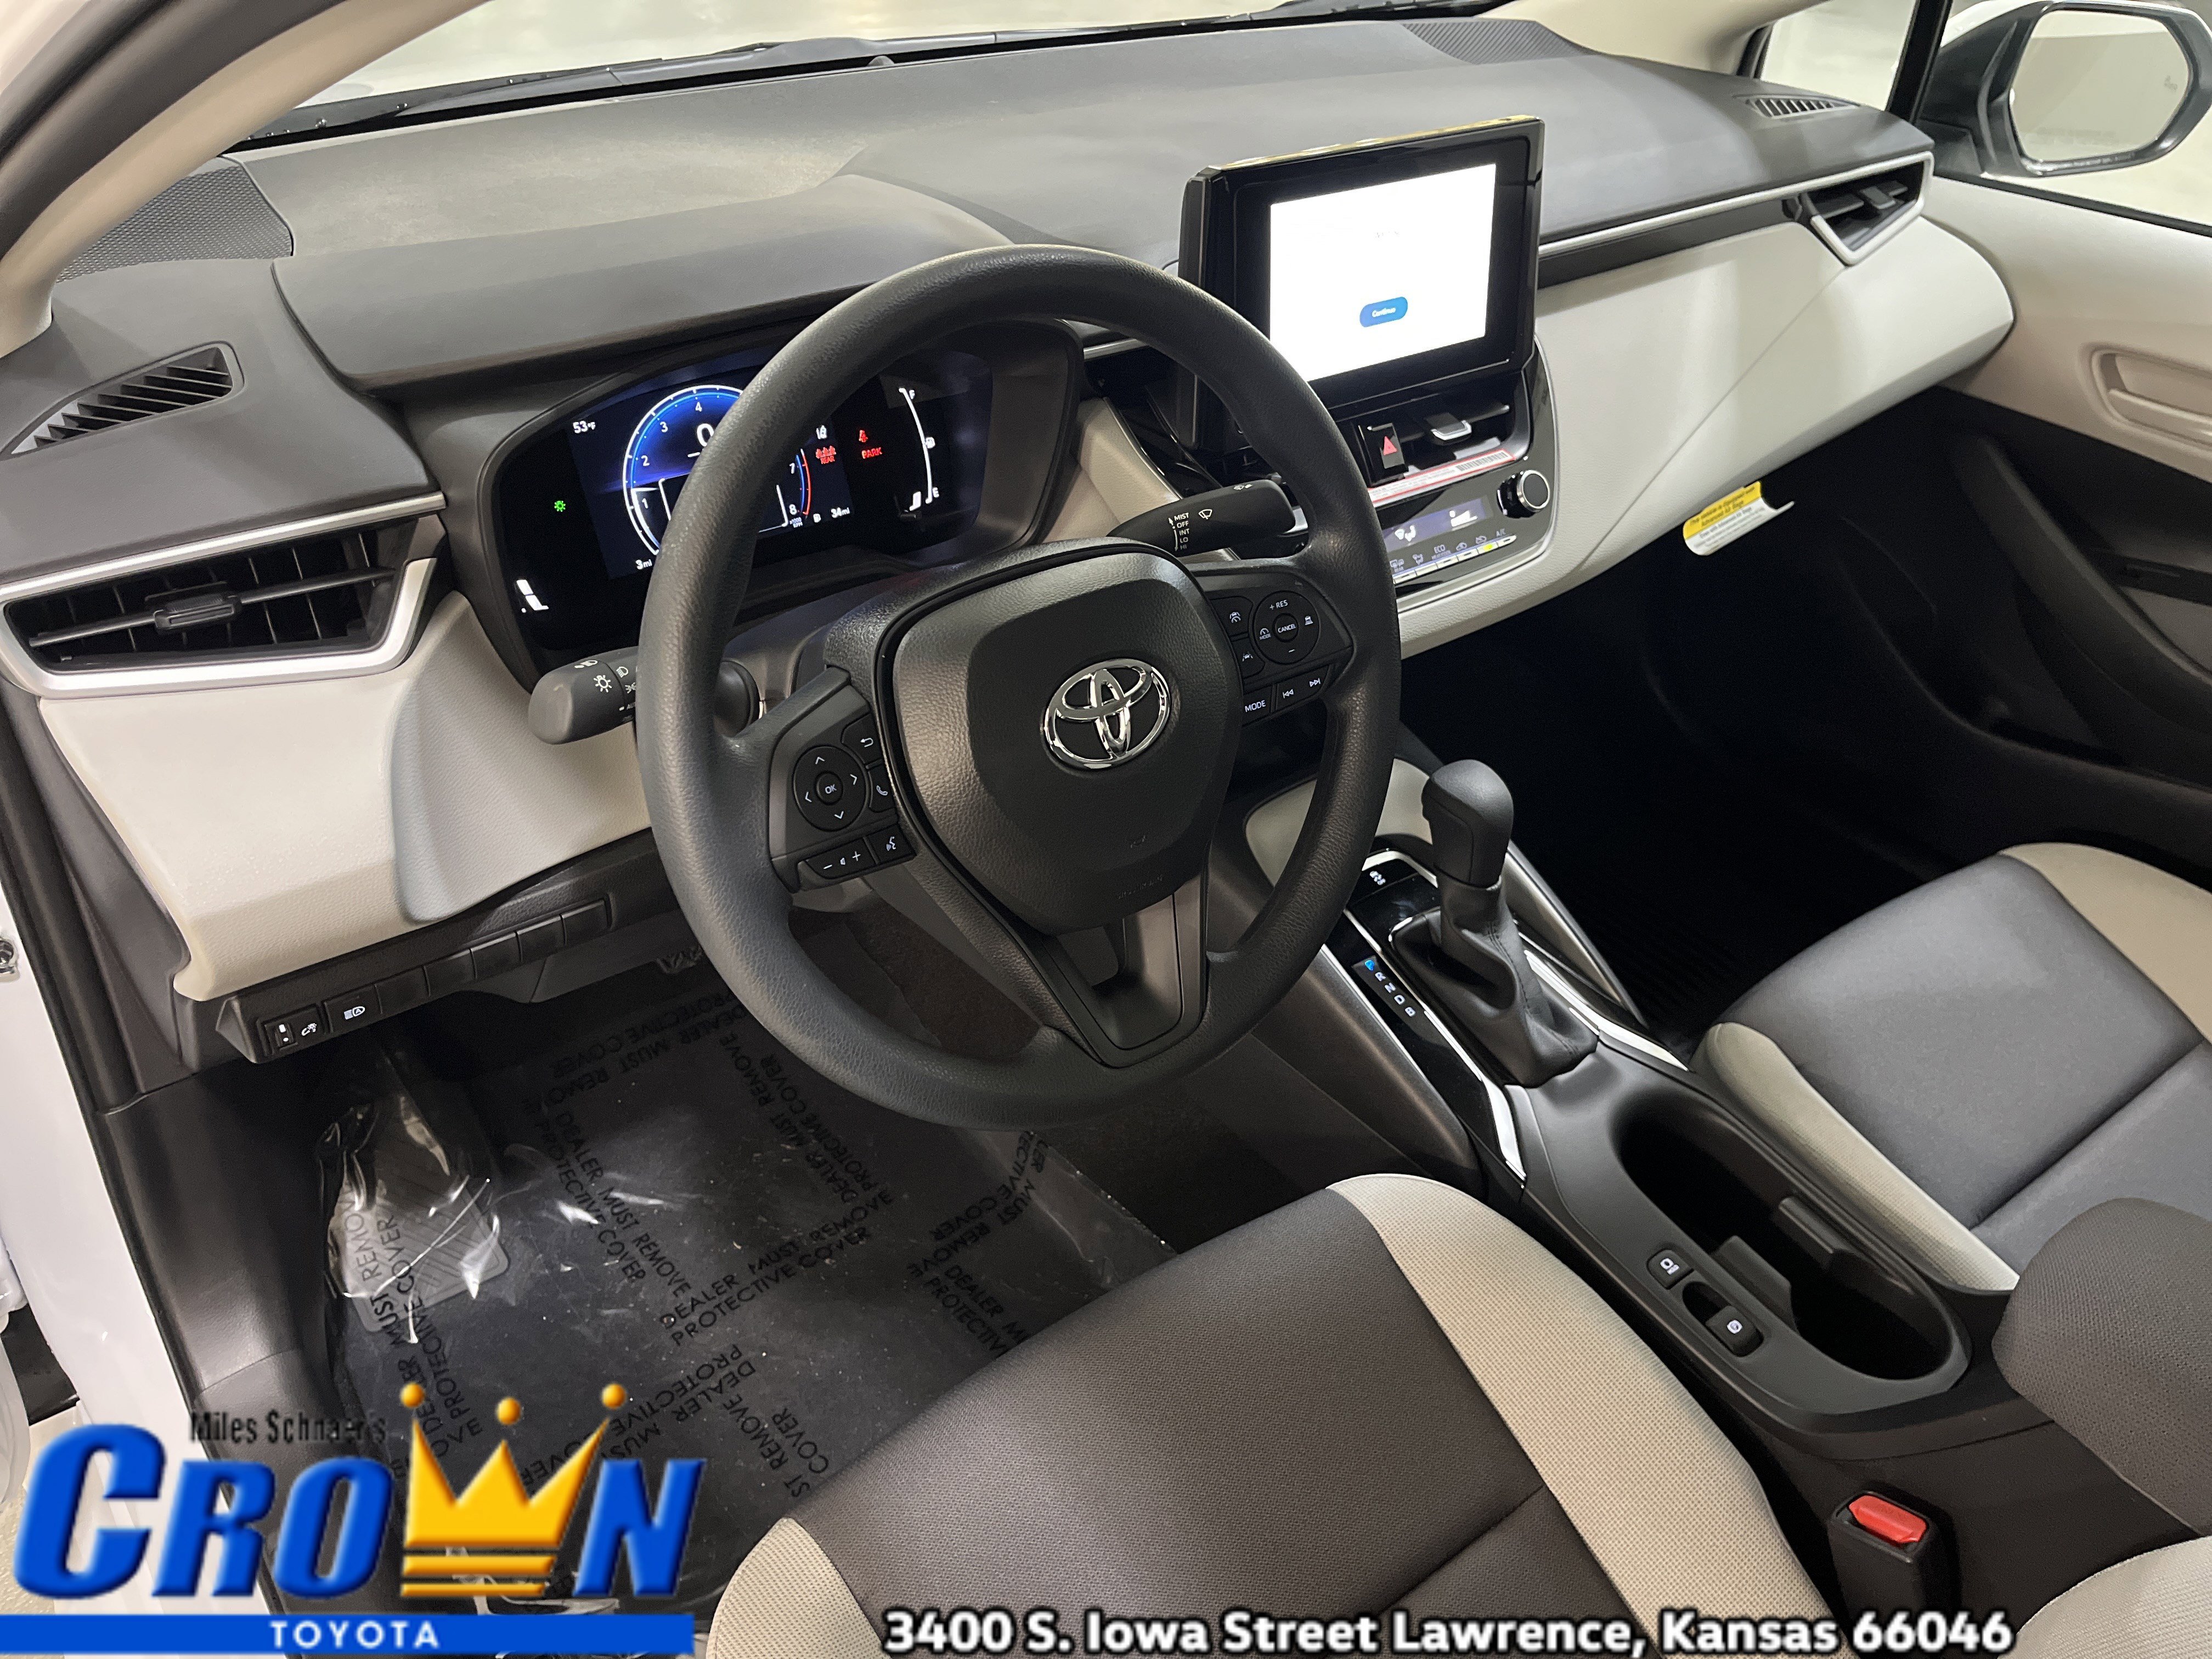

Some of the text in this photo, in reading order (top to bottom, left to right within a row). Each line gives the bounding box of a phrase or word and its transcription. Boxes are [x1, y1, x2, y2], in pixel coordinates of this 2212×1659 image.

[659, 421, 668, 432] 3
[695, 402, 702, 412] 4
[641, 455, 650, 466] 2
[789, 462, 795, 474] 7
[820, 455, 836, 464] REAR
[861, 447, 882, 459] PARK
[642, 498, 648, 509] 1
[789, 504, 797, 515] 8
[932, 487, 940, 498] E
[1174, 512, 1189, 521] MIST
[1496, 528, 1506, 537] A/C
[1434, 544, 1446, 554] ECO
[1276, 600, 1288, 608] RES
[1278, 623, 1296, 633] CANCEL
[1245, 699, 1266, 713] MODE
[825, 784, 837, 794] OK
[1375, 972, 1386, 981] R
[1384, 982, 1396, 994] N
[1393, 995, 1406, 1005] D
[1404, 1007, 1416, 1017] B
[619, 1040, 670, 1073] MUST
[719, 1032, 774, 1107] REMOVE
[760, 1053, 806, 1114] COVER
[555, 1113, 692, 1297] DEALER MUST REMOVE
[930, 1196, 997, 1241] COVER
[996, 1178, 1035, 1225] MUST
[377, 1214, 414, 1294] COVER
[598, 1229, 646, 1279] COVER
[660, 1189, 894, 1329] DEALER MUST REMOVE
[907, 1222, 991, 1278] REMOVE
[671, 1226, 872, 1346] PROTECTIVE COVER
[944, 1264, 1004, 1317] DEALER
[370, 1293, 407, 1345] MUST
[610, 1344, 743, 1437] PROTECTIVE
[670, 1361, 755, 1423] DEALER
[723, 1393, 789, 1470] REMOVE
[771, 1408, 830, 1474] COVER
